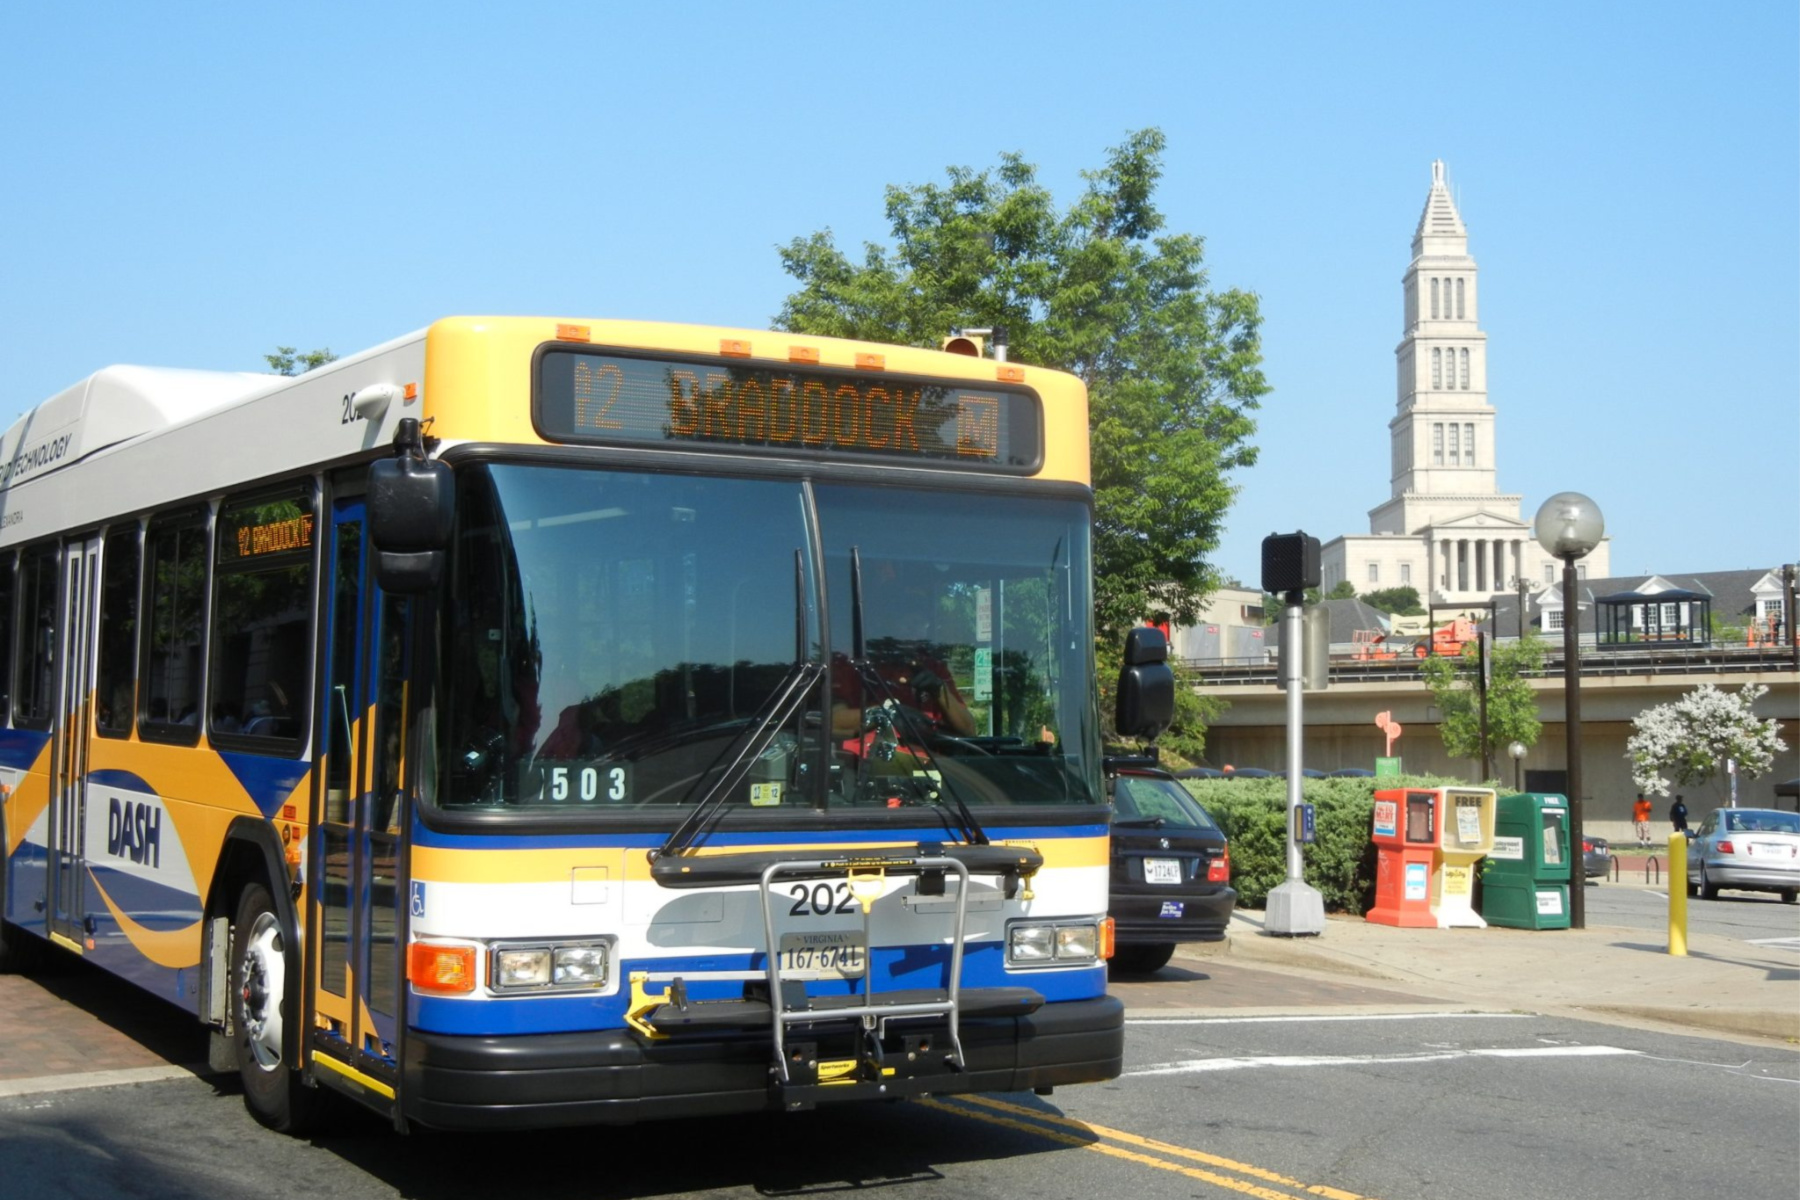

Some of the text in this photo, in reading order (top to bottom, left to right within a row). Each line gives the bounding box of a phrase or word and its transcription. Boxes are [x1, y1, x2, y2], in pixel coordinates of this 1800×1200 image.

[342, 391, 364, 424] 20
[671, 369, 920, 452] BRADDOCK
[13, 432, 72, 477] TECHNOLOGY
[1455, 796, 1482, 808] FREE
[108, 798, 161, 869] DASH
[789, 882, 856, 916] 202
[803, 934, 844, 944] VIRGINIA
